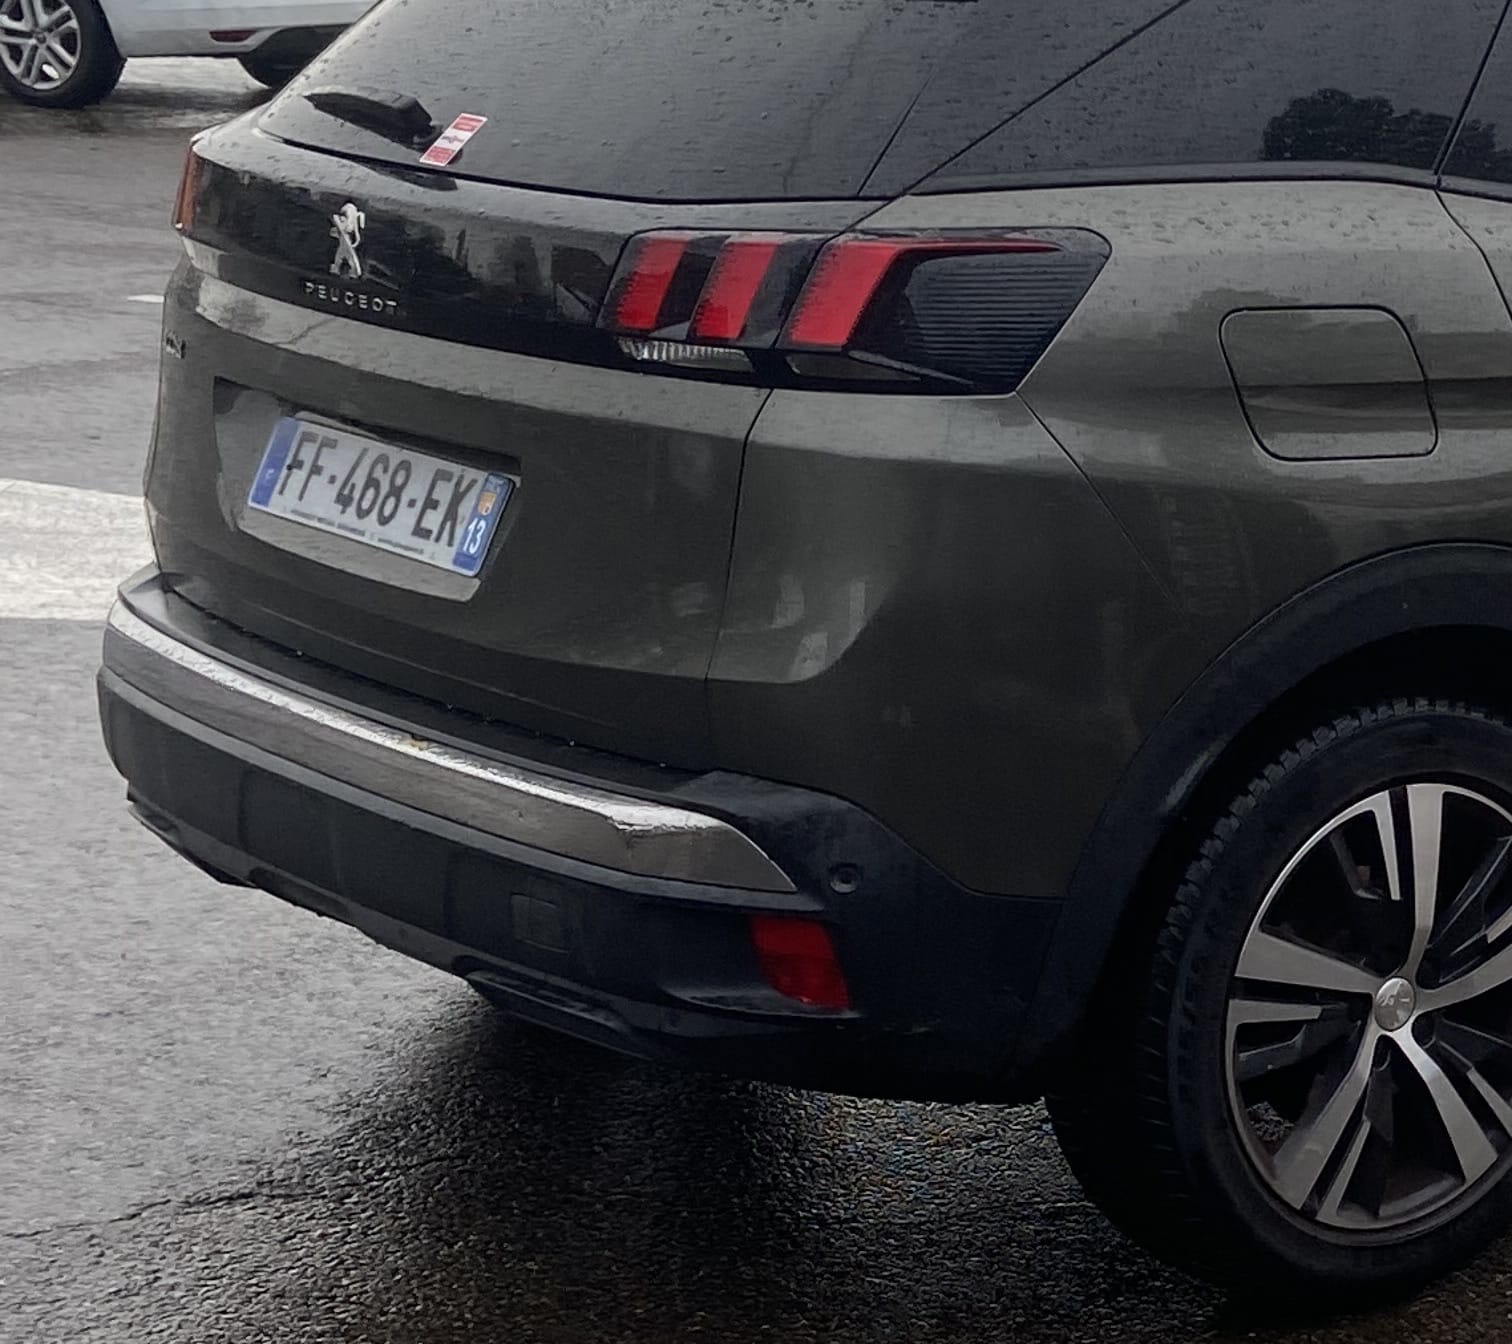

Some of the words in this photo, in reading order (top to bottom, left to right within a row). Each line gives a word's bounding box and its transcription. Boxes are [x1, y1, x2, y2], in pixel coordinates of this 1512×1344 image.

[304, 281, 399, 314] PEUGEOT
[278, 431, 478, 548] FF-468-EK
[463, 517, 487, 555] 13
